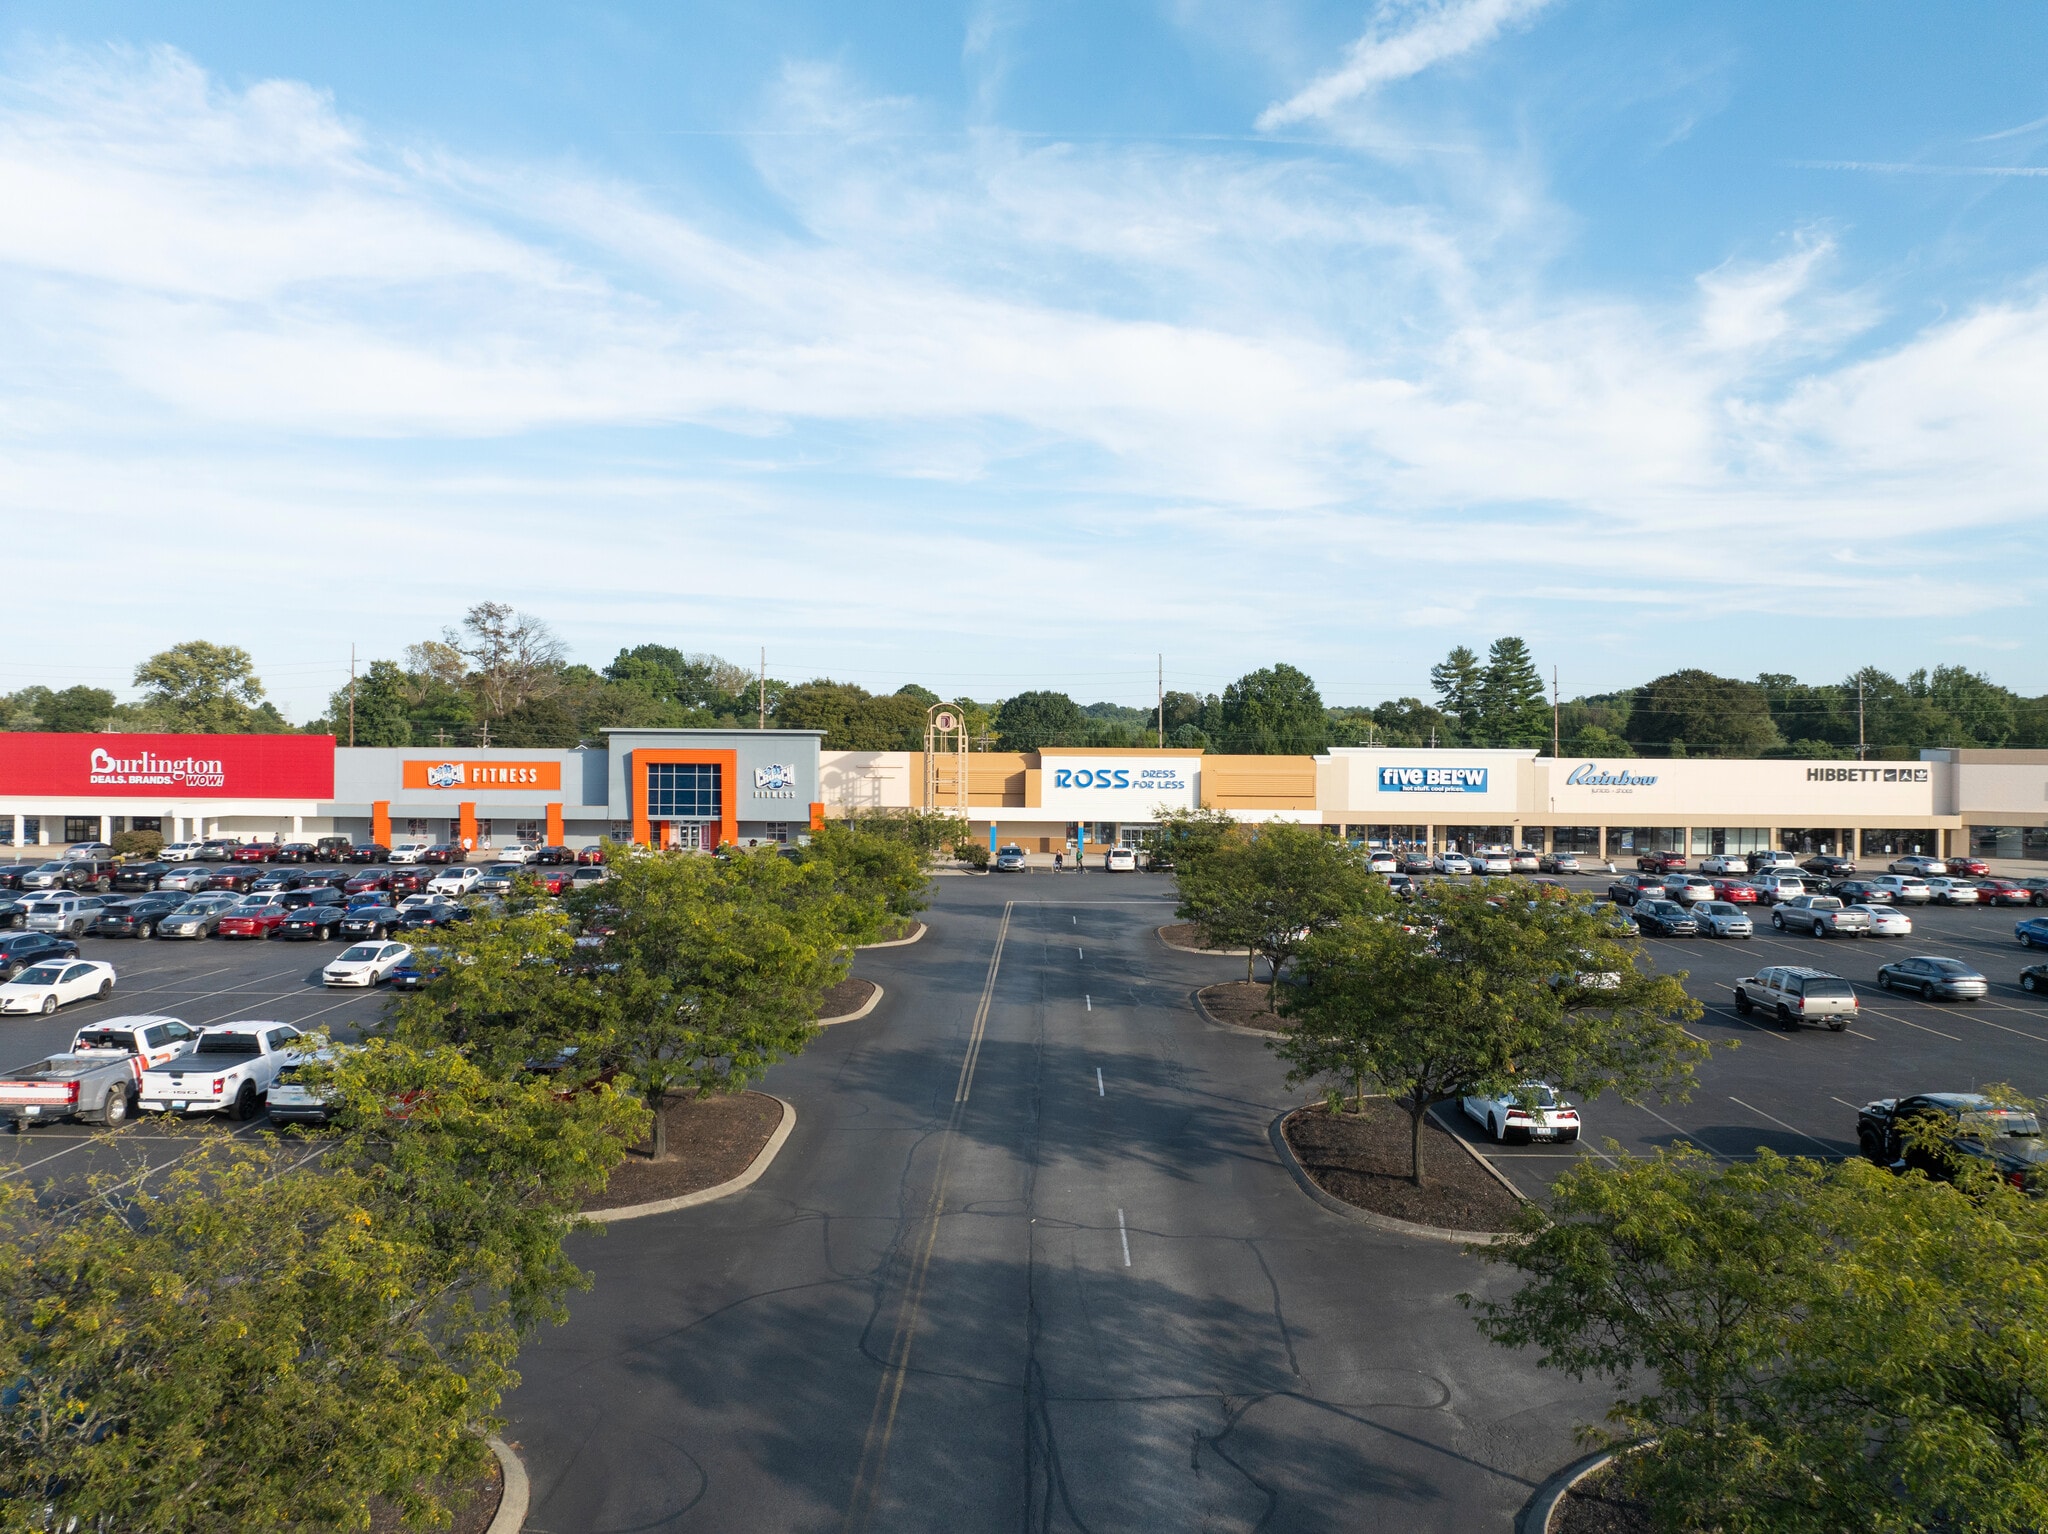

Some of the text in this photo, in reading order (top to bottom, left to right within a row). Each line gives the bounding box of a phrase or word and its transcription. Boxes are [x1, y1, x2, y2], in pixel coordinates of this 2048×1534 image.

[90, 748, 223, 780] Burlington
[90, 774, 225, 787] DEALS. BRANDS. WOW!
[472, 768, 537, 783] FITNESS
[1055, 769, 1130, 789] ROSS
[1142, 770, 1176, 779] DRESS
[1383, 768, 1424, 785] five
[1566, 762, 1658, 786] Rainbow
[1807, 768, 1882, 782] HIBBETT
[1132, 780, 1185, 790] FOR LESS
[753, 791, 795, 799] FITNESS
